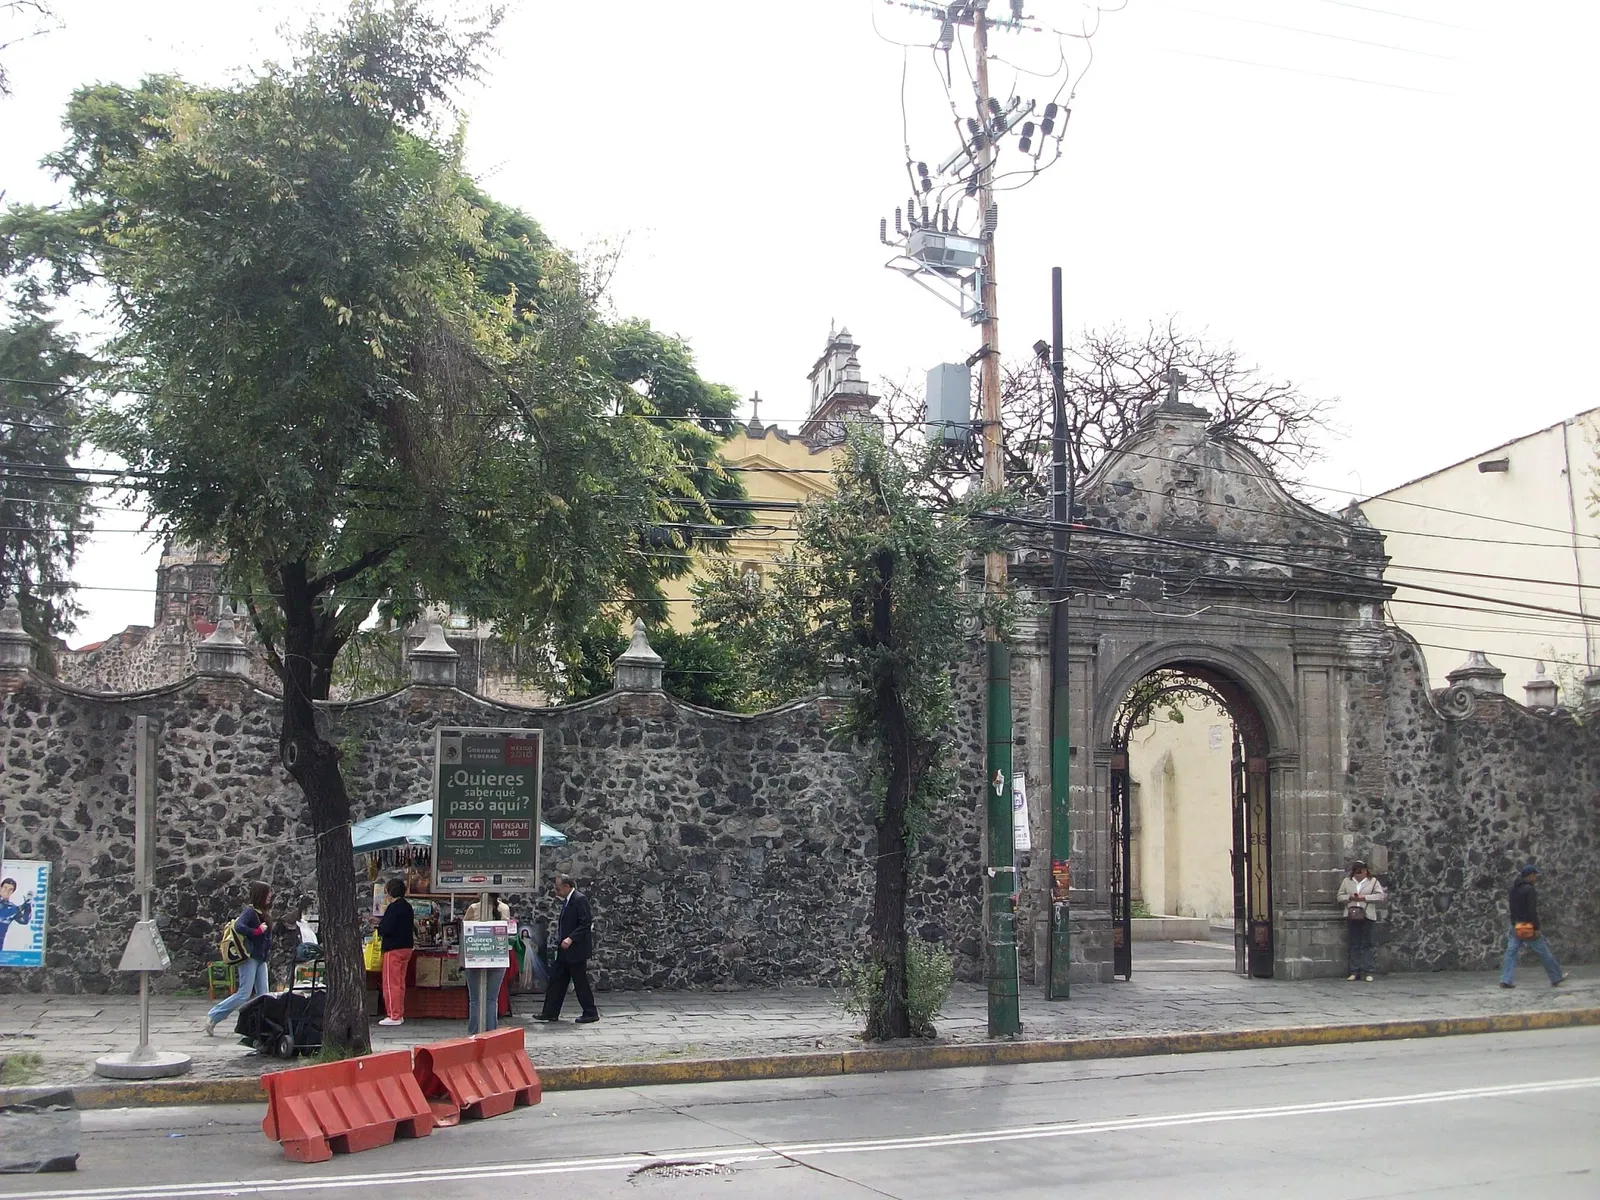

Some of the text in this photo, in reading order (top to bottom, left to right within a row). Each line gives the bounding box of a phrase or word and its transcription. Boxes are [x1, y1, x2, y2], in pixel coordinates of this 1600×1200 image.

[448, 769, 524, 787] ¿Quieres
[464, 787, 515, 800] saber qué
[450, 796, 530, 815] pasó aquí?
[29, 867, 48, 949] infinitum
